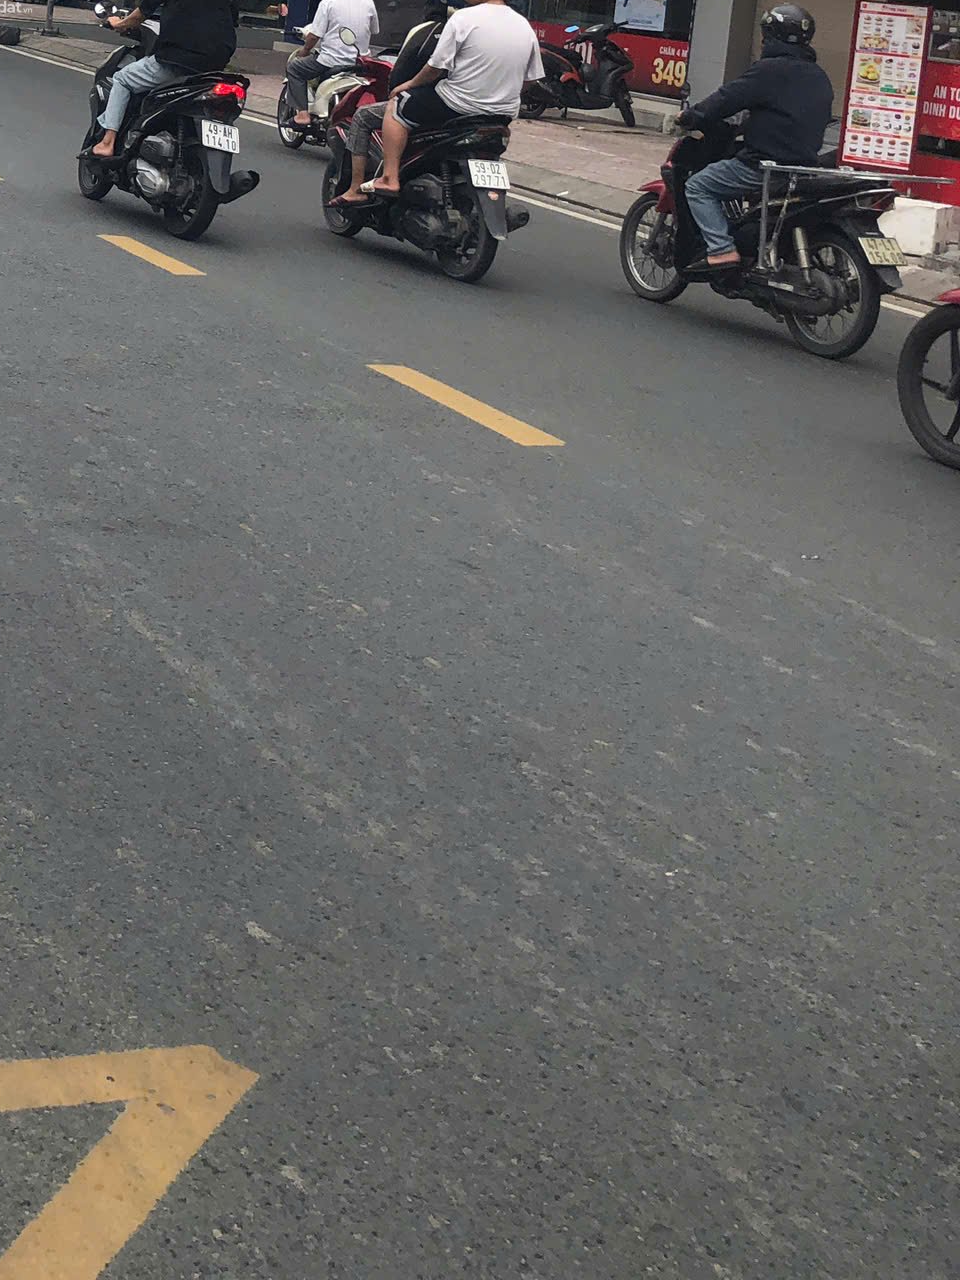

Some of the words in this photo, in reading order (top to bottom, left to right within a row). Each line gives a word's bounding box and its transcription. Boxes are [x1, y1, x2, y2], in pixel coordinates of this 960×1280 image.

[651, 57, 687, 88] 349
[933, 85, 948, 99] AN
[923, 101, 946, 121] DINH
[208, 123, 233, 138] 49-AH
